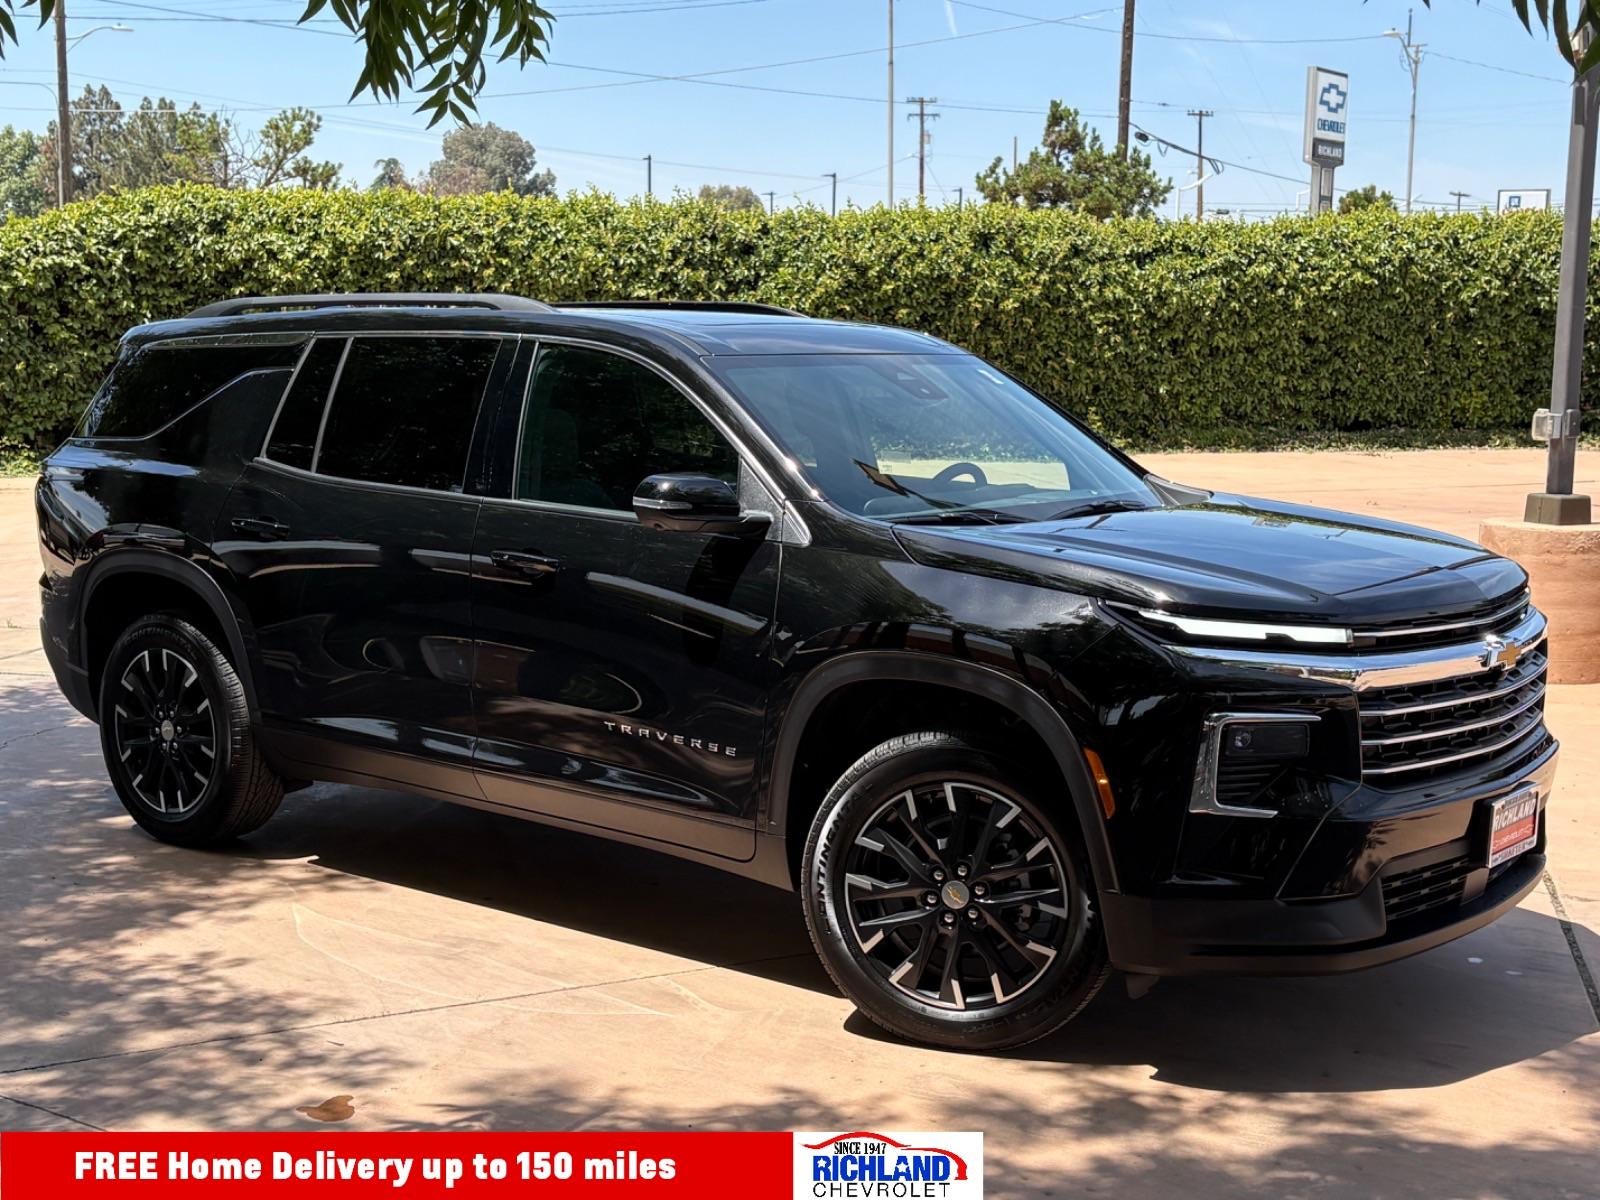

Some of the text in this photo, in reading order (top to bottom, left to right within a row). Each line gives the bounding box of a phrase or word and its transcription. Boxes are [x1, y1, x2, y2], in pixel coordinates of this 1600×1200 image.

[1317, 118, 1346, 134] CHEVROLET
[604, 721, 737, 757] TRAVERSE
[1495, 798, 1536, 831] RICHLAND
